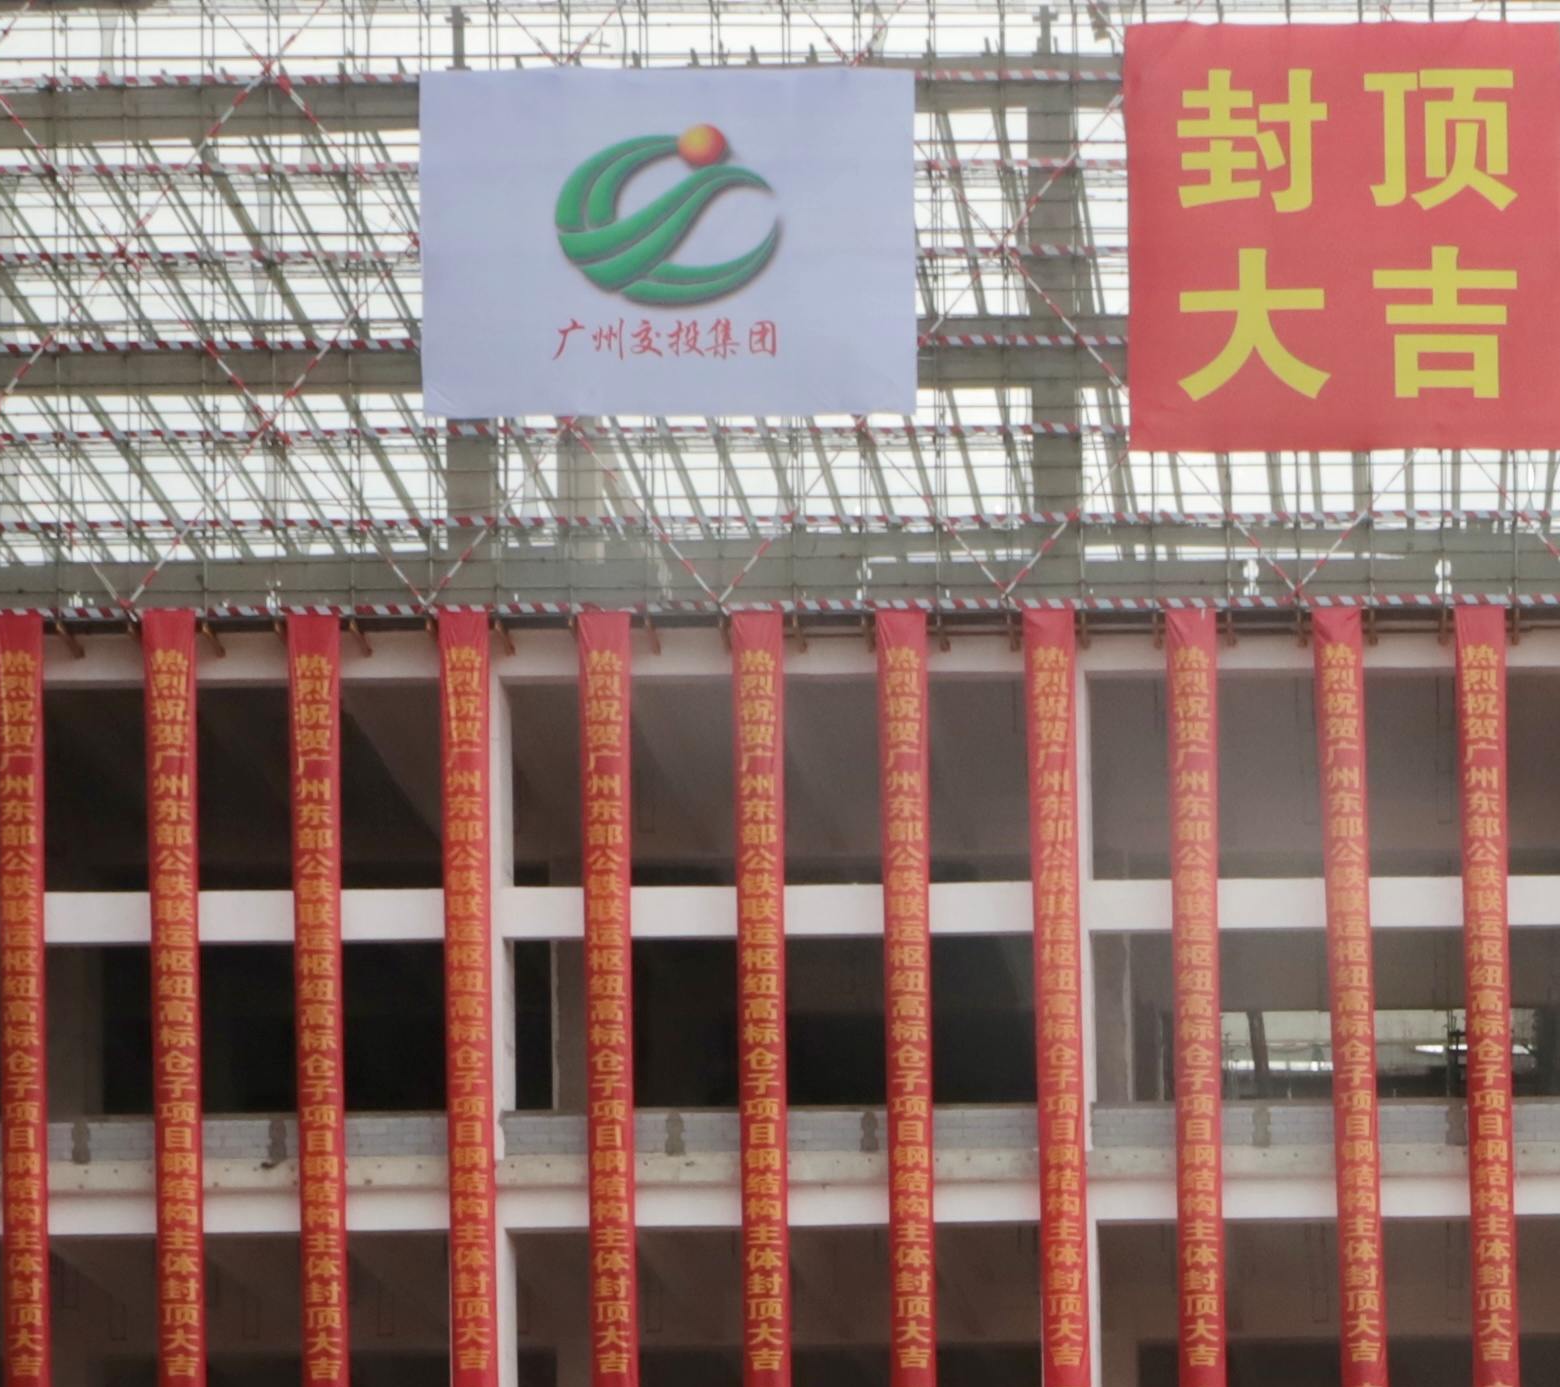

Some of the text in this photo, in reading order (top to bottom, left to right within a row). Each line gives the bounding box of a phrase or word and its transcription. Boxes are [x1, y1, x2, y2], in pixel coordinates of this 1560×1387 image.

[1177, 66, 1517, 215] 封顶
[551, 316, 780, 364] 广州交投集团
[1178, 245, 1517, 400] 大吉
